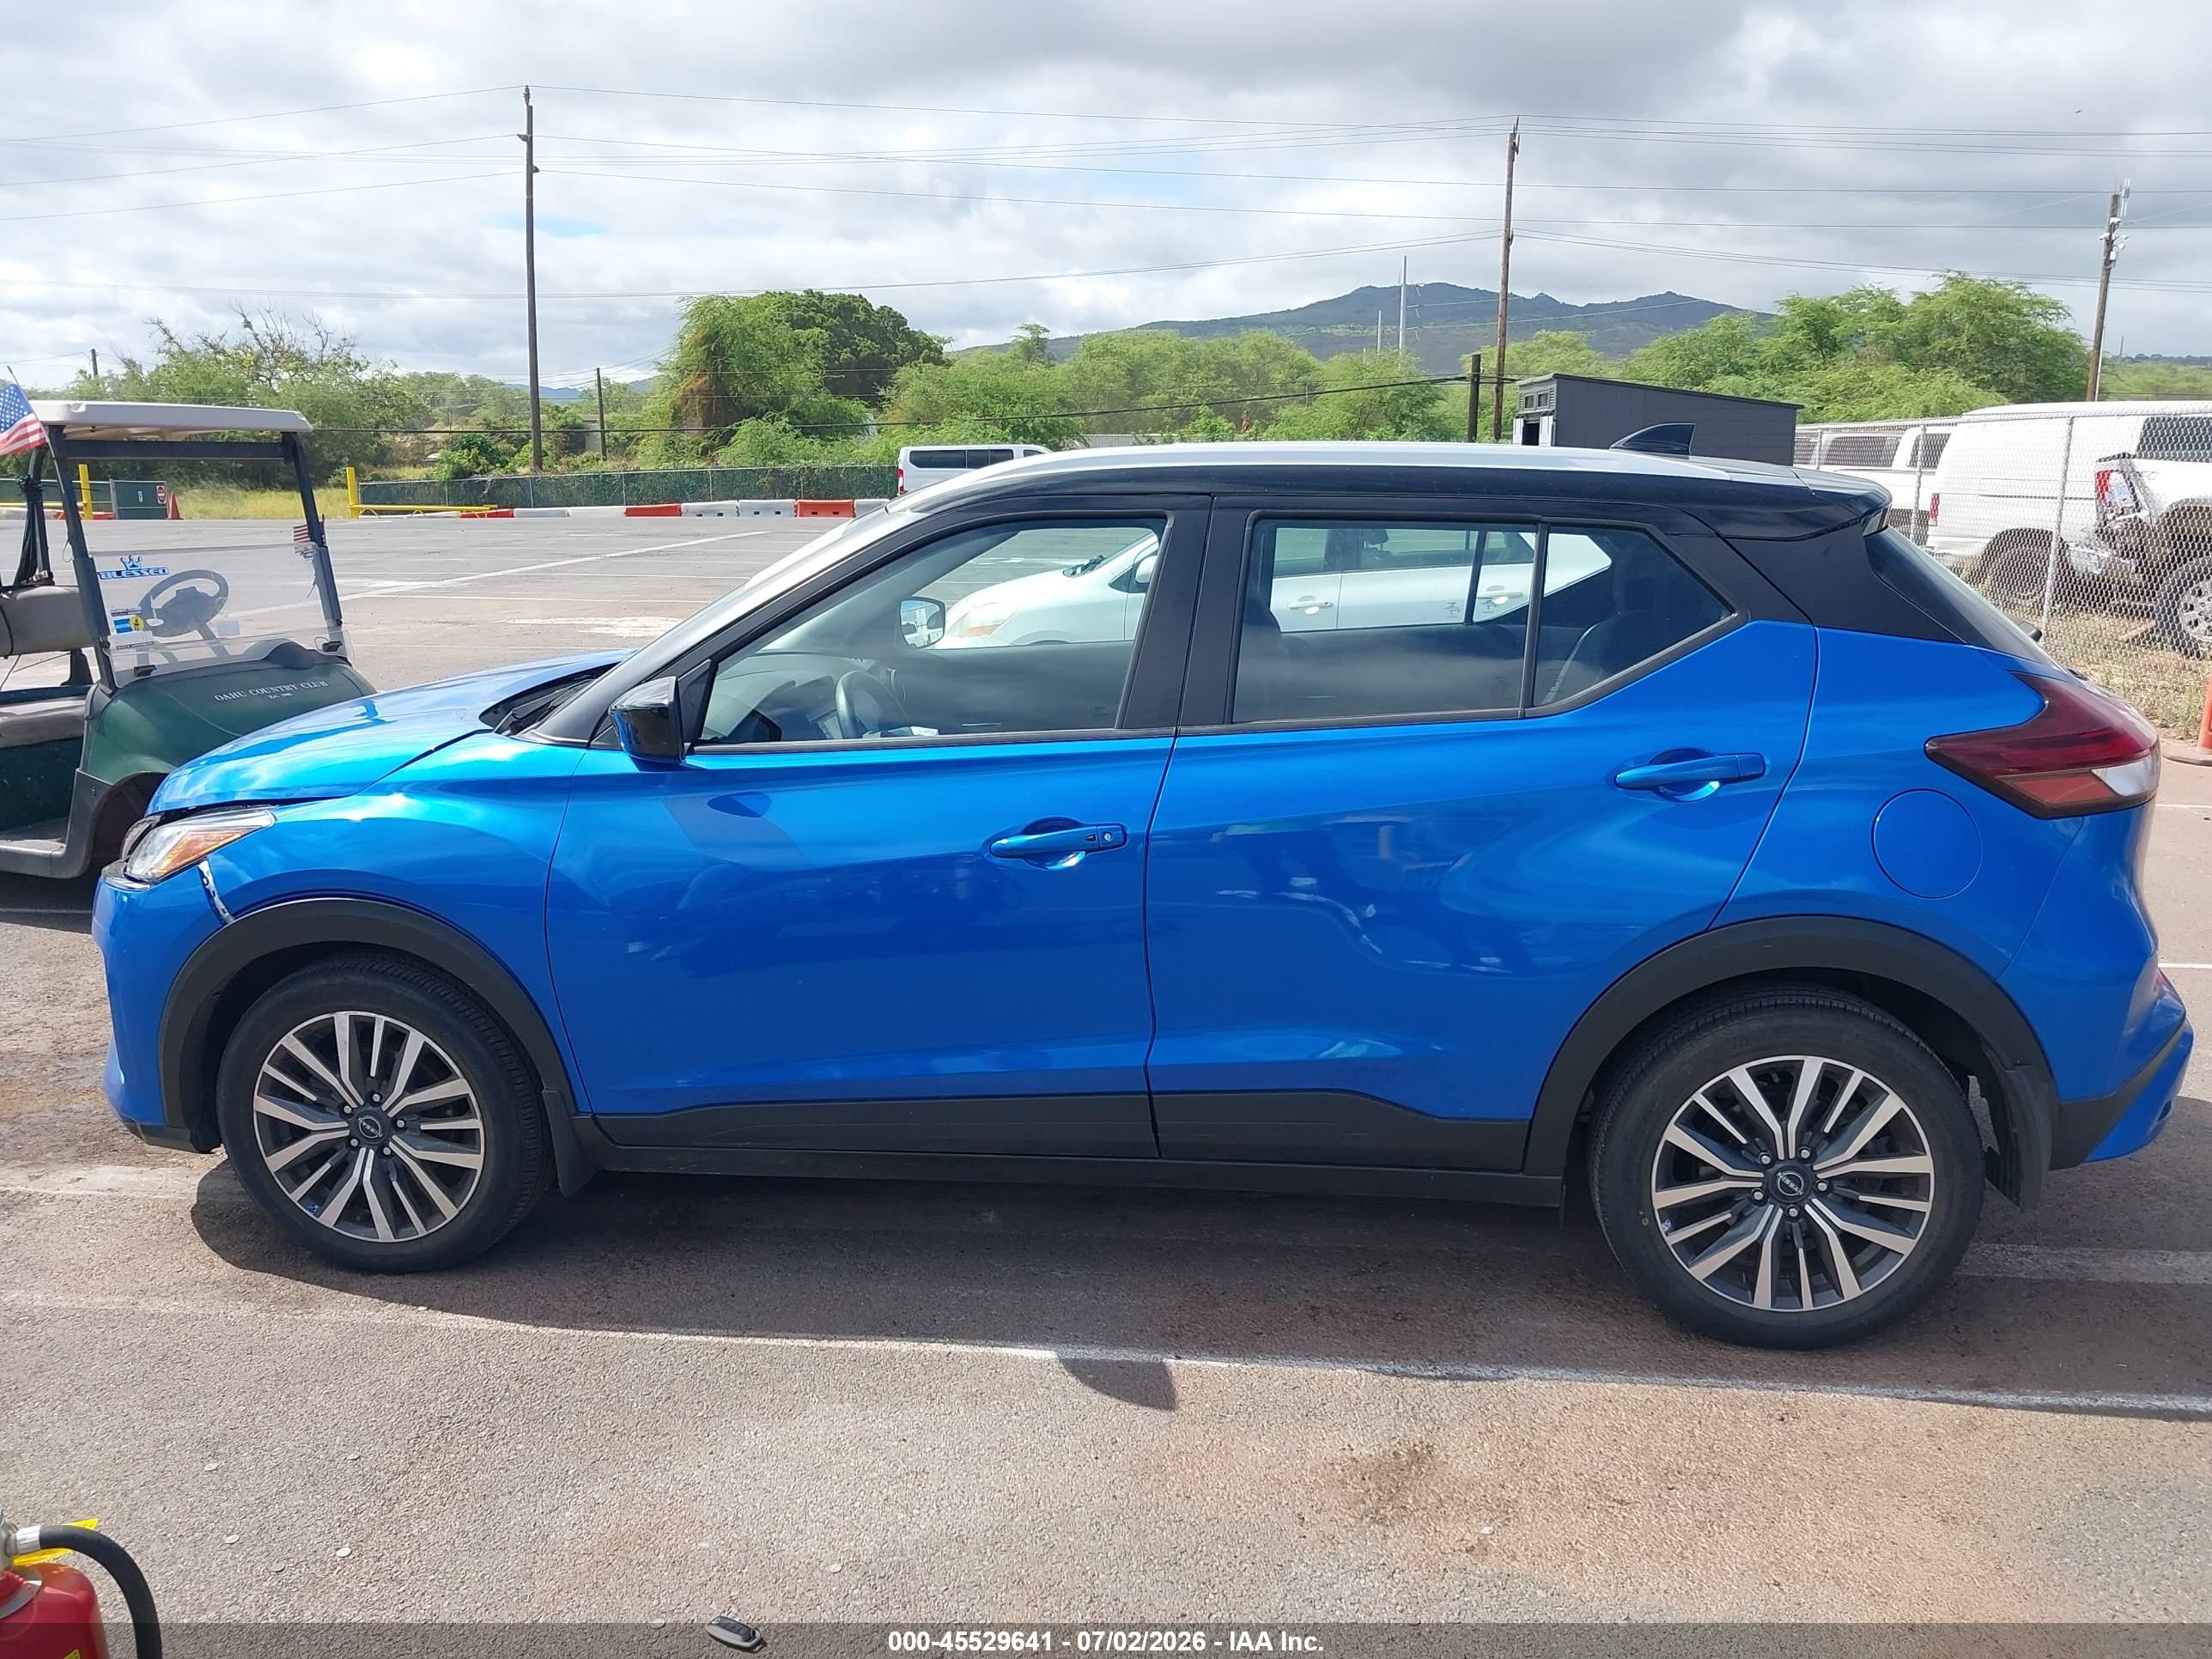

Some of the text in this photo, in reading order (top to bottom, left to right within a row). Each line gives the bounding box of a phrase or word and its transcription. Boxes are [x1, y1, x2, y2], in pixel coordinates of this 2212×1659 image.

[98, 567, 169, 580] BLESSED
[214, 690, 247, 702] OAHU
[248, 684, 298, 696] COUNTRY
[300, 680, 329, 689] CLUB
[1777, 1171, 1804, 1196] NISSAN
